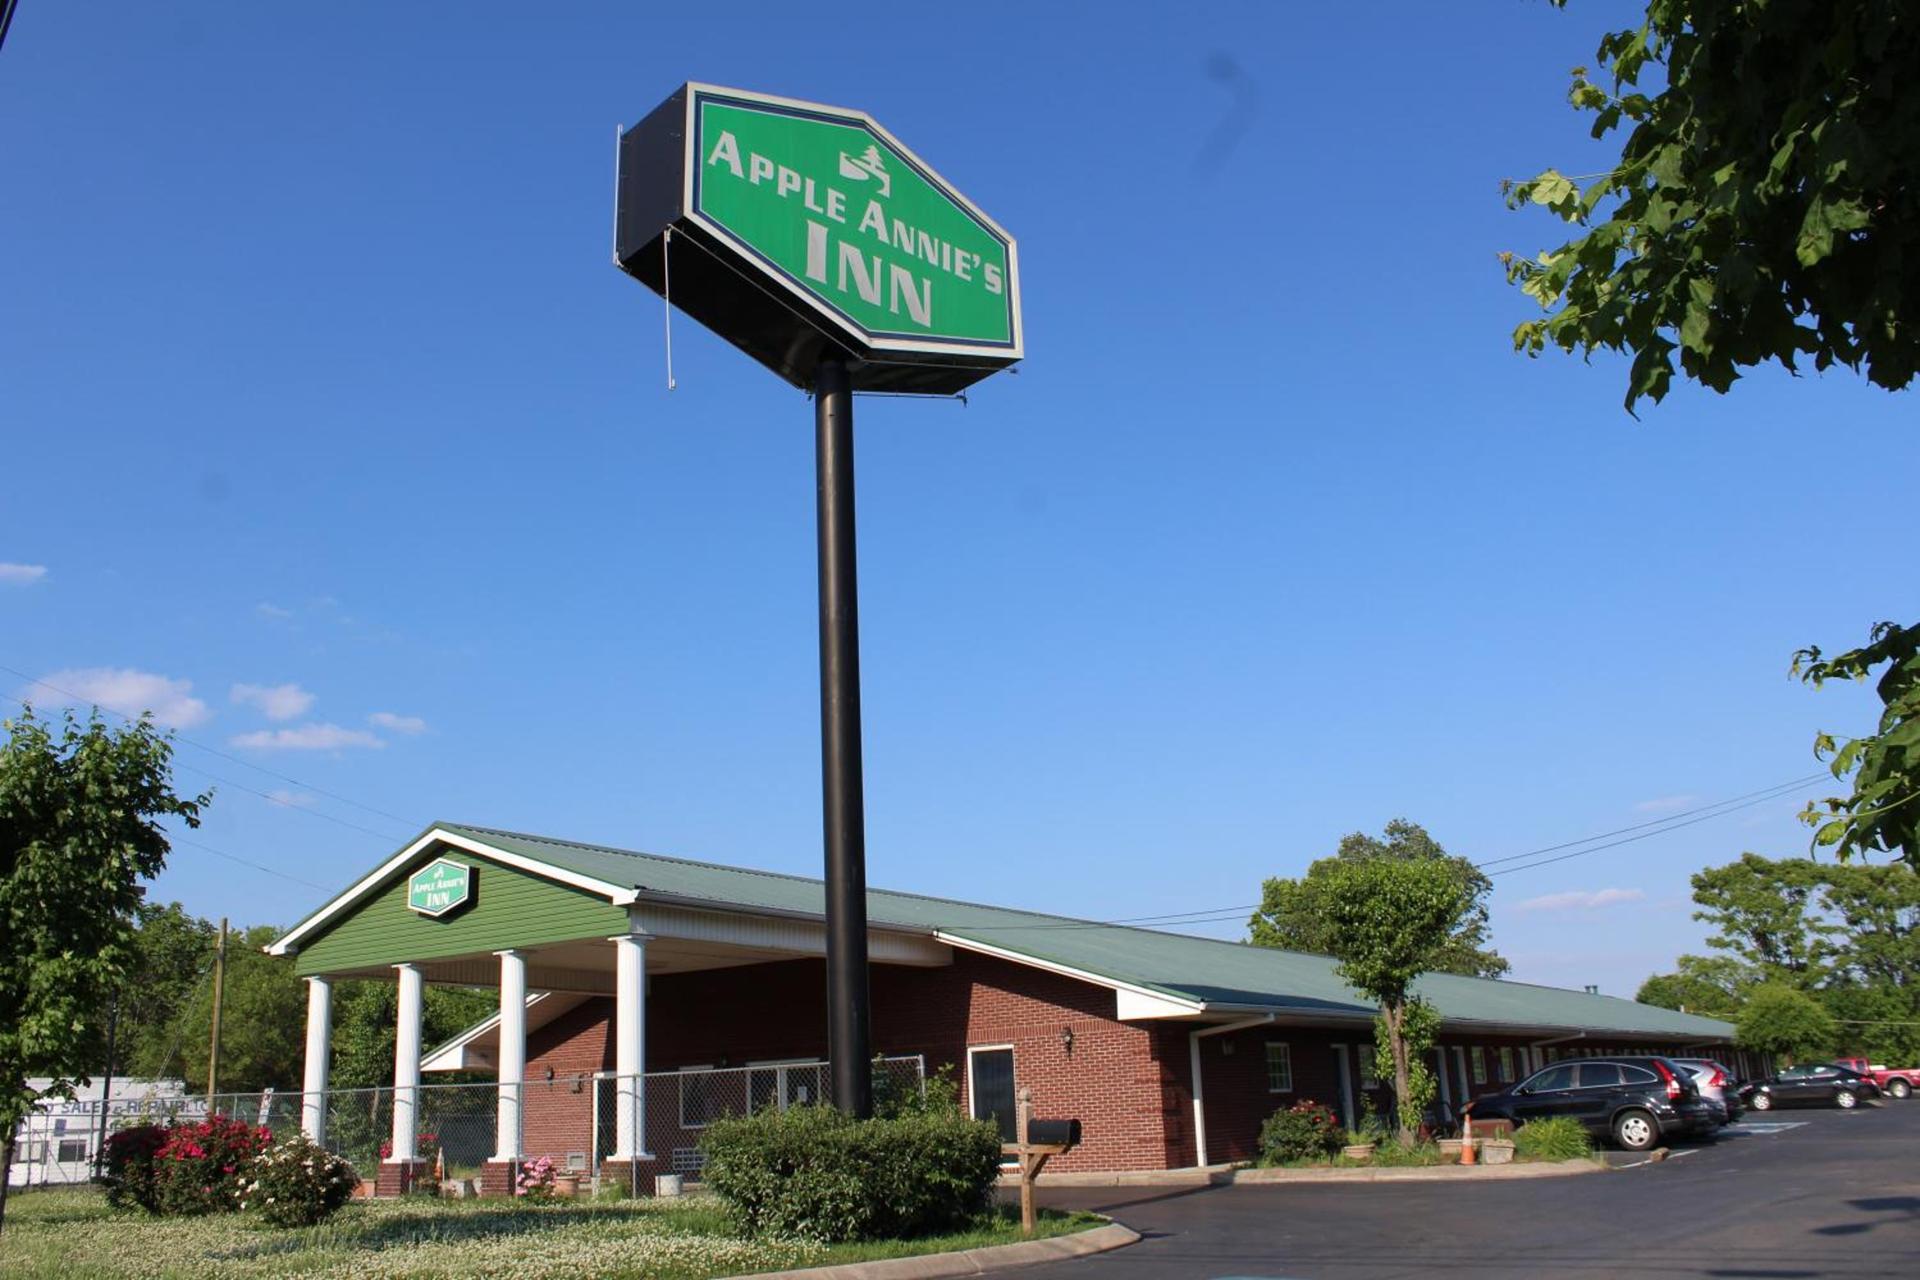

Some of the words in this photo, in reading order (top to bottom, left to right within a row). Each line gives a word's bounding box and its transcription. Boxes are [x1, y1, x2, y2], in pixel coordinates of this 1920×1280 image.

[707, 130, 846, 224] APPLE
[858, 199, 1002, 295] ANNIE'S
[804, 218, 932, 328] INN
[426, 890, 450, 906] INN
[61, 1101, 111, 1114] SALE
